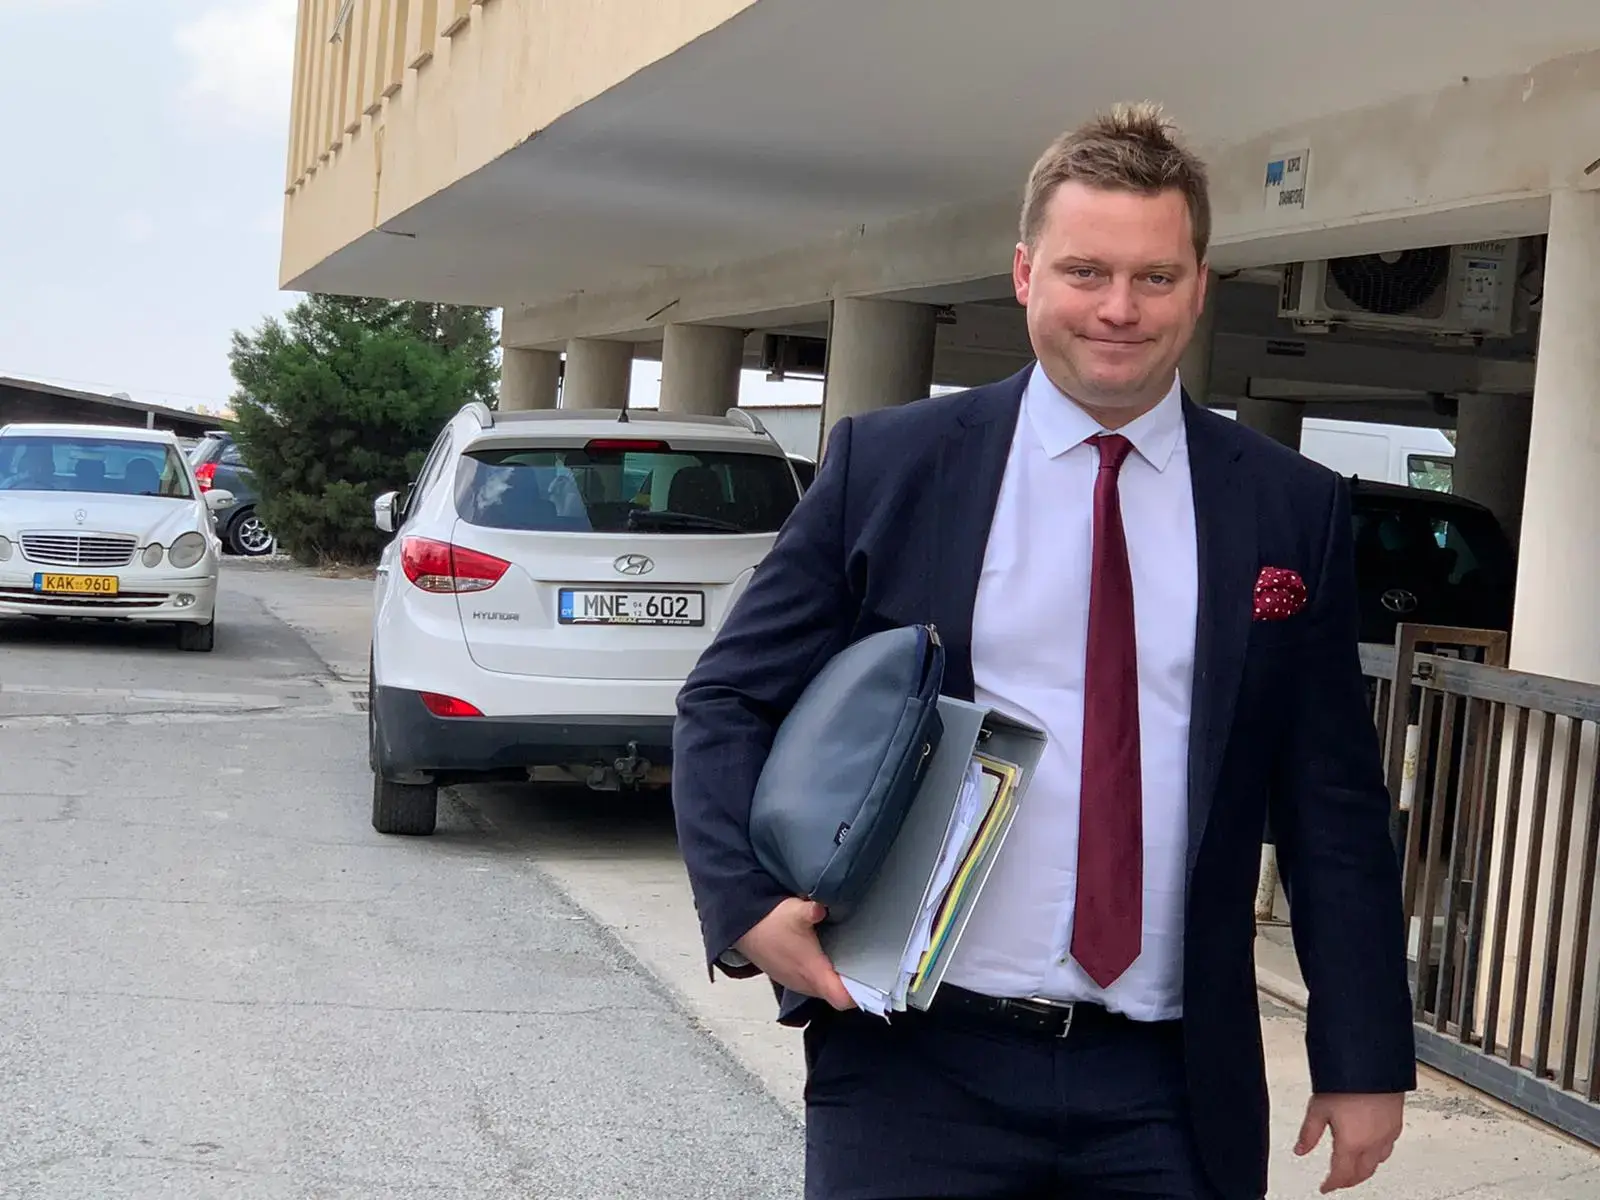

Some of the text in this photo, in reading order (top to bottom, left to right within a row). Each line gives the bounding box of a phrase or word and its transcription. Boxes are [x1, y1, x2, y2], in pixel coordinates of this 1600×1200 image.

[46, 576, 75, 590] KAK
[84, 578, 111, 591] 960
[561, 608, 573, 616] CY
[583, 594, 689, 618] MNE 602
